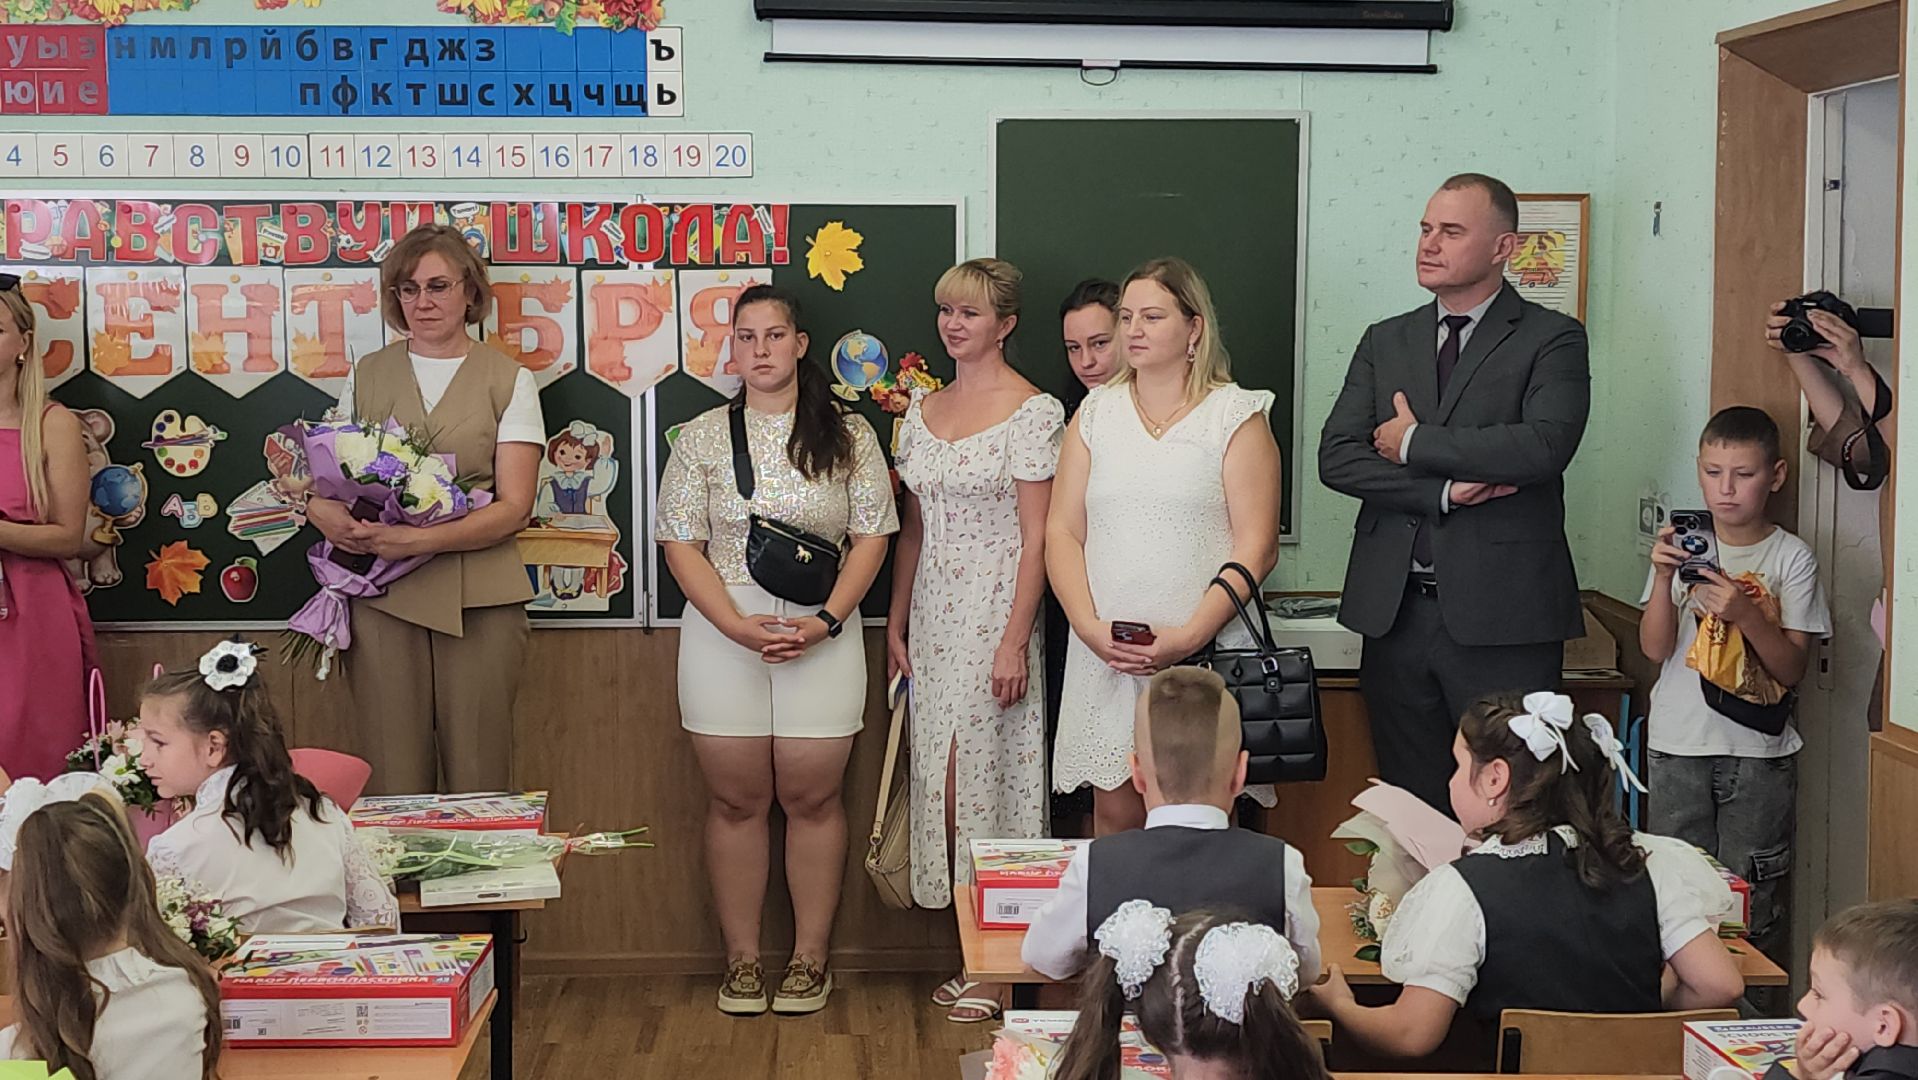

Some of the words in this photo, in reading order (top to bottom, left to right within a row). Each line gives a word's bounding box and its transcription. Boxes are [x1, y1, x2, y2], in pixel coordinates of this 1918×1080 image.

[7, 145, 22, 167] 4
[53, 145, 68, 167] 5
[99, 145, 114, 167] 6
[144, 145, 159, 167] 7
[190, 145, 205, 167] 8
[234, 145, 250, 167] 9
[271, 145, 301, 167] 10
[320, 145, 345, 167] 11
[361, 145, 391, 167] 12
[406, 145, 437, 167] 13
[452, 145, 482, 167] 14
[496, 145, 526, 167] 15
[540, 145, 570, 167] 16
[583, 145, 613, 167] 17
[629, 145, 658, 167] 18
[674, 145, 701, 167] 19
[715, 145, 746, 167] 20
[490, 202, 790, 265] ШКОЛА!
